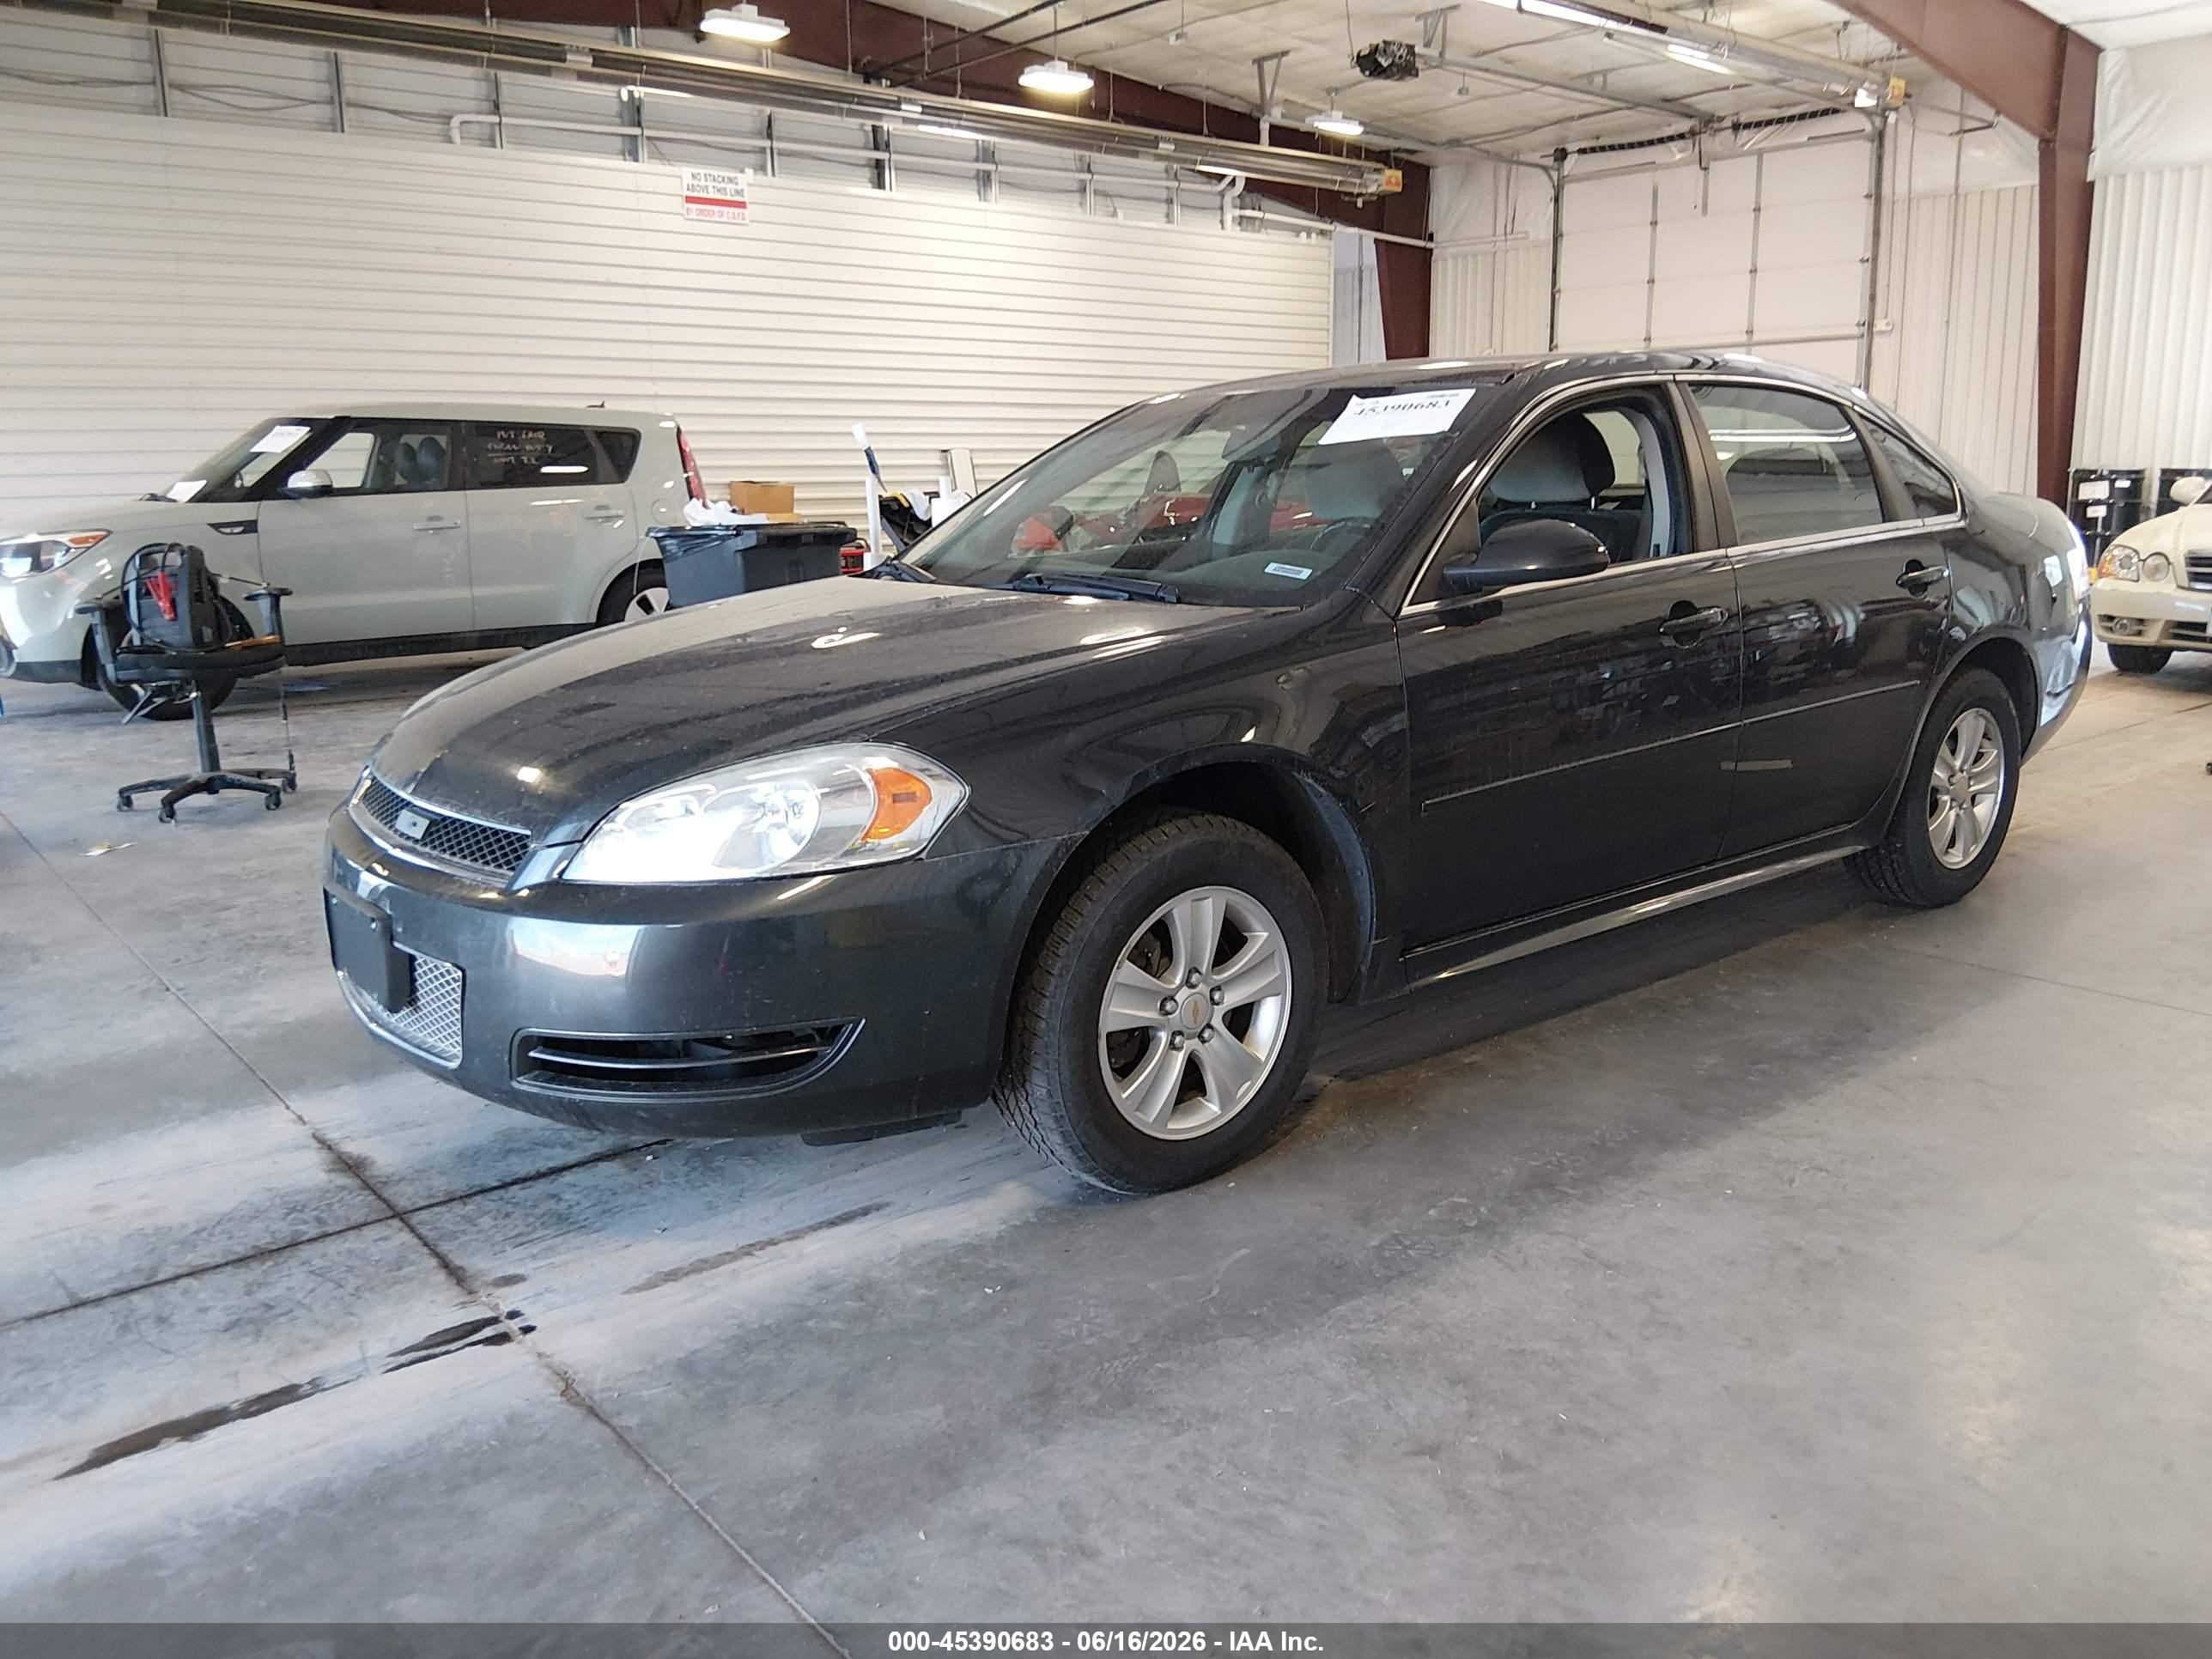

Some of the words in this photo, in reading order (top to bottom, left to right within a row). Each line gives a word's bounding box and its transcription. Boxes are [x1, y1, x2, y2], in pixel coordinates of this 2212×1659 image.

[691, 172, 702, 182] NO
[703, 173, 738, 185] STACKING
[686, 183, 710, 194] ABOVE
[712, 185, 727, 196] THIS
[730, 187, 745, 198] LINE
[695, 208, 715, 218] ORDER
[717, 210, 725, 218] OF
